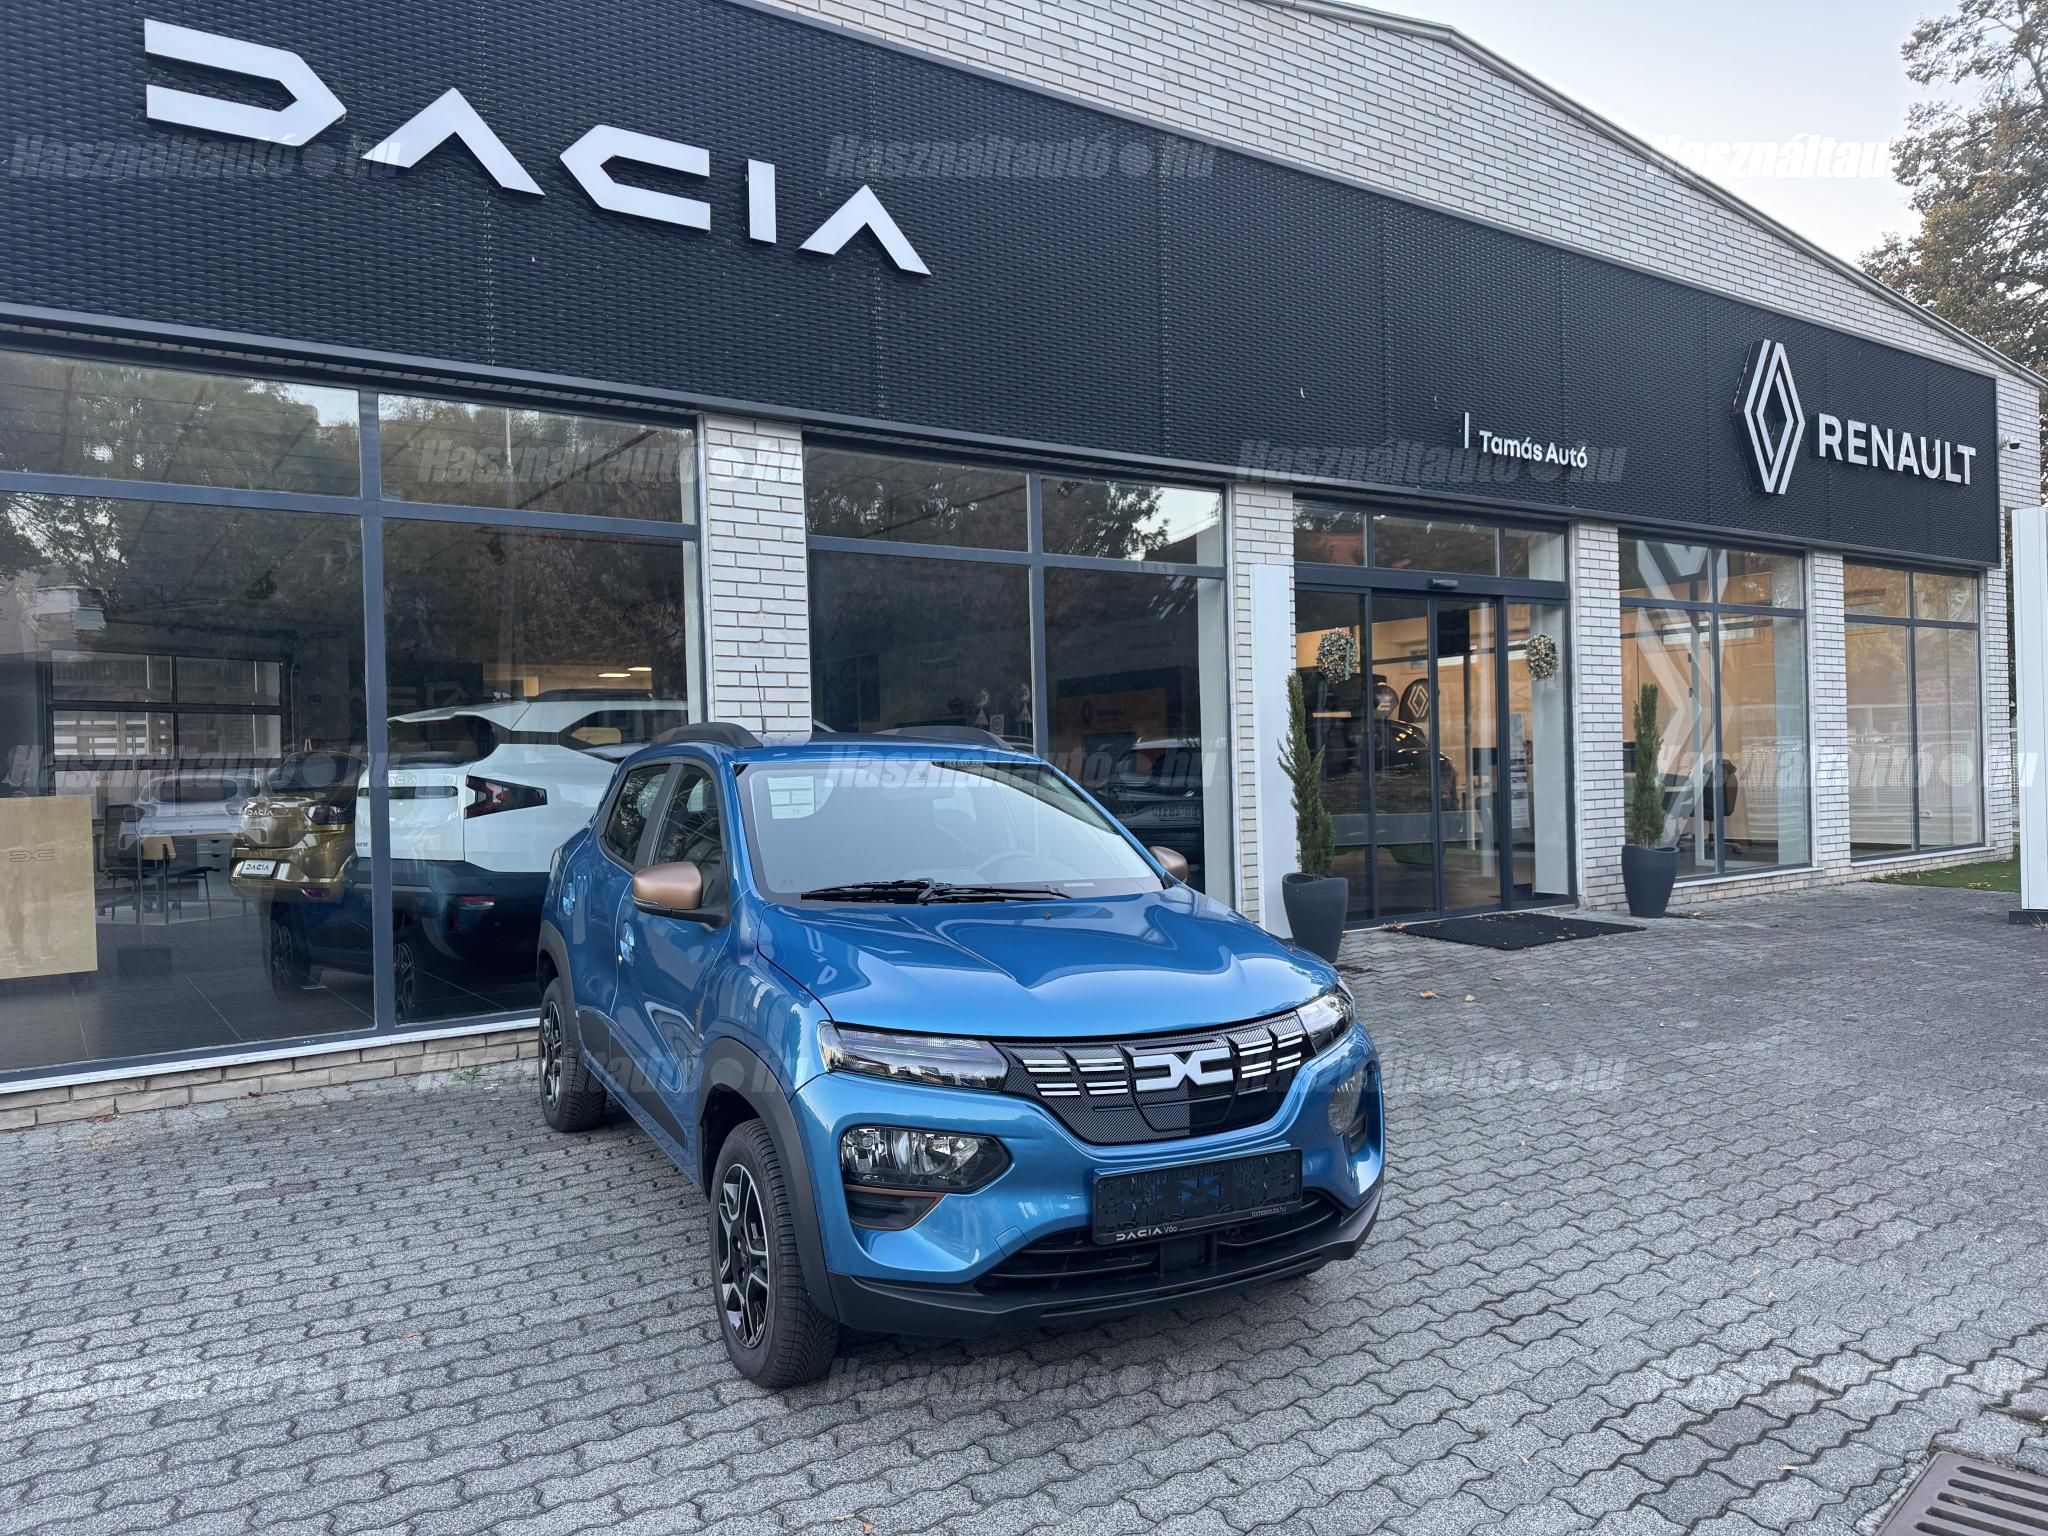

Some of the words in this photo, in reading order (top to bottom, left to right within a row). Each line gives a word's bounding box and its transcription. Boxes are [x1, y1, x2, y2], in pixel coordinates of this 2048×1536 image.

[144, 18, 932, 276] DACIA
[1478, 429, 1543, 462] Tamás
[1545, 441, 1589, 469] Autó
[1818, 412, 1977, 486] RENAULT
[245, 863, 270, 871] DACIA
[1115, 1227, 1163, 1241] DACIA
